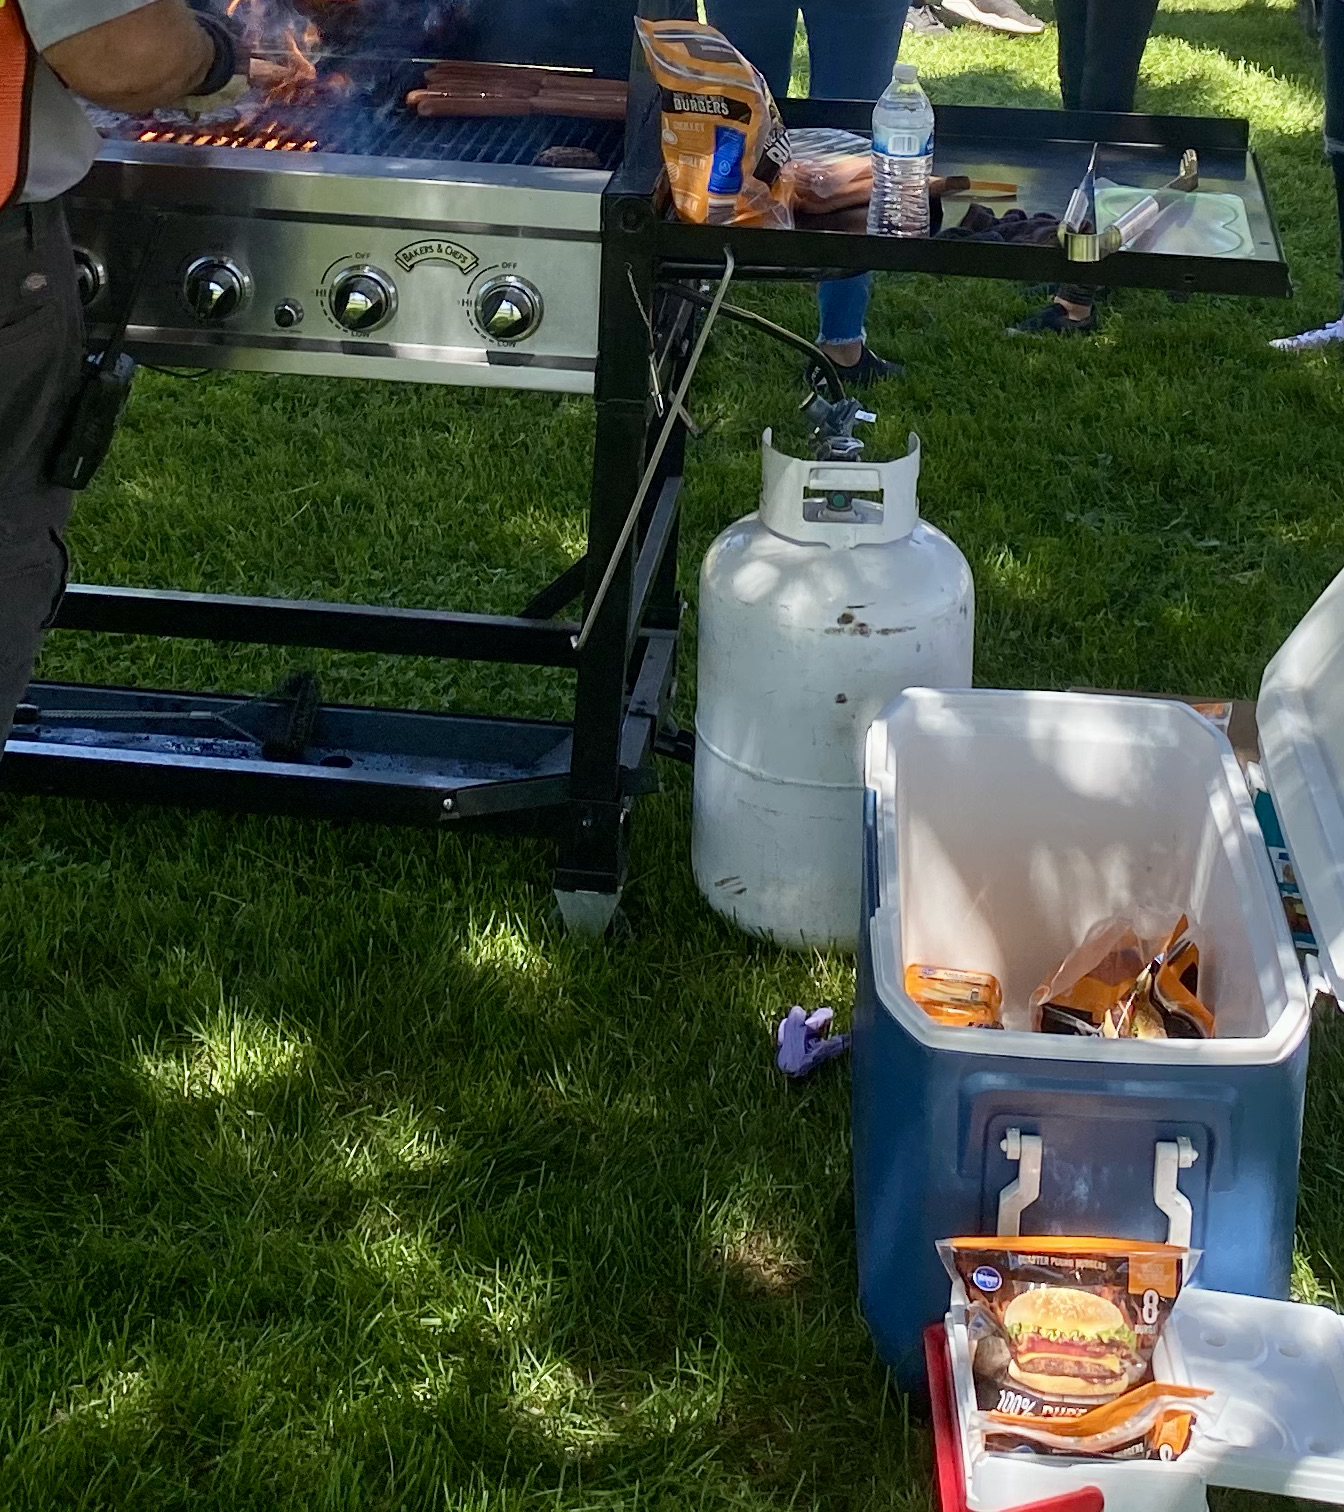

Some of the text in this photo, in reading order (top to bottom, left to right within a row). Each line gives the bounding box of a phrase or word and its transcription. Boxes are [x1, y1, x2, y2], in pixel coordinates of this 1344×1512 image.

[673, 97, 730, 116] BURGERS
[355, 251, 372, 259] OFF
[401, 243, 469, 264] BAKERS & CHEFS
[501, 261, 518, 270] OFF
[1143, 1289, 1160, 1324] 8
[997, 1390, 1036, 1416] 100%
